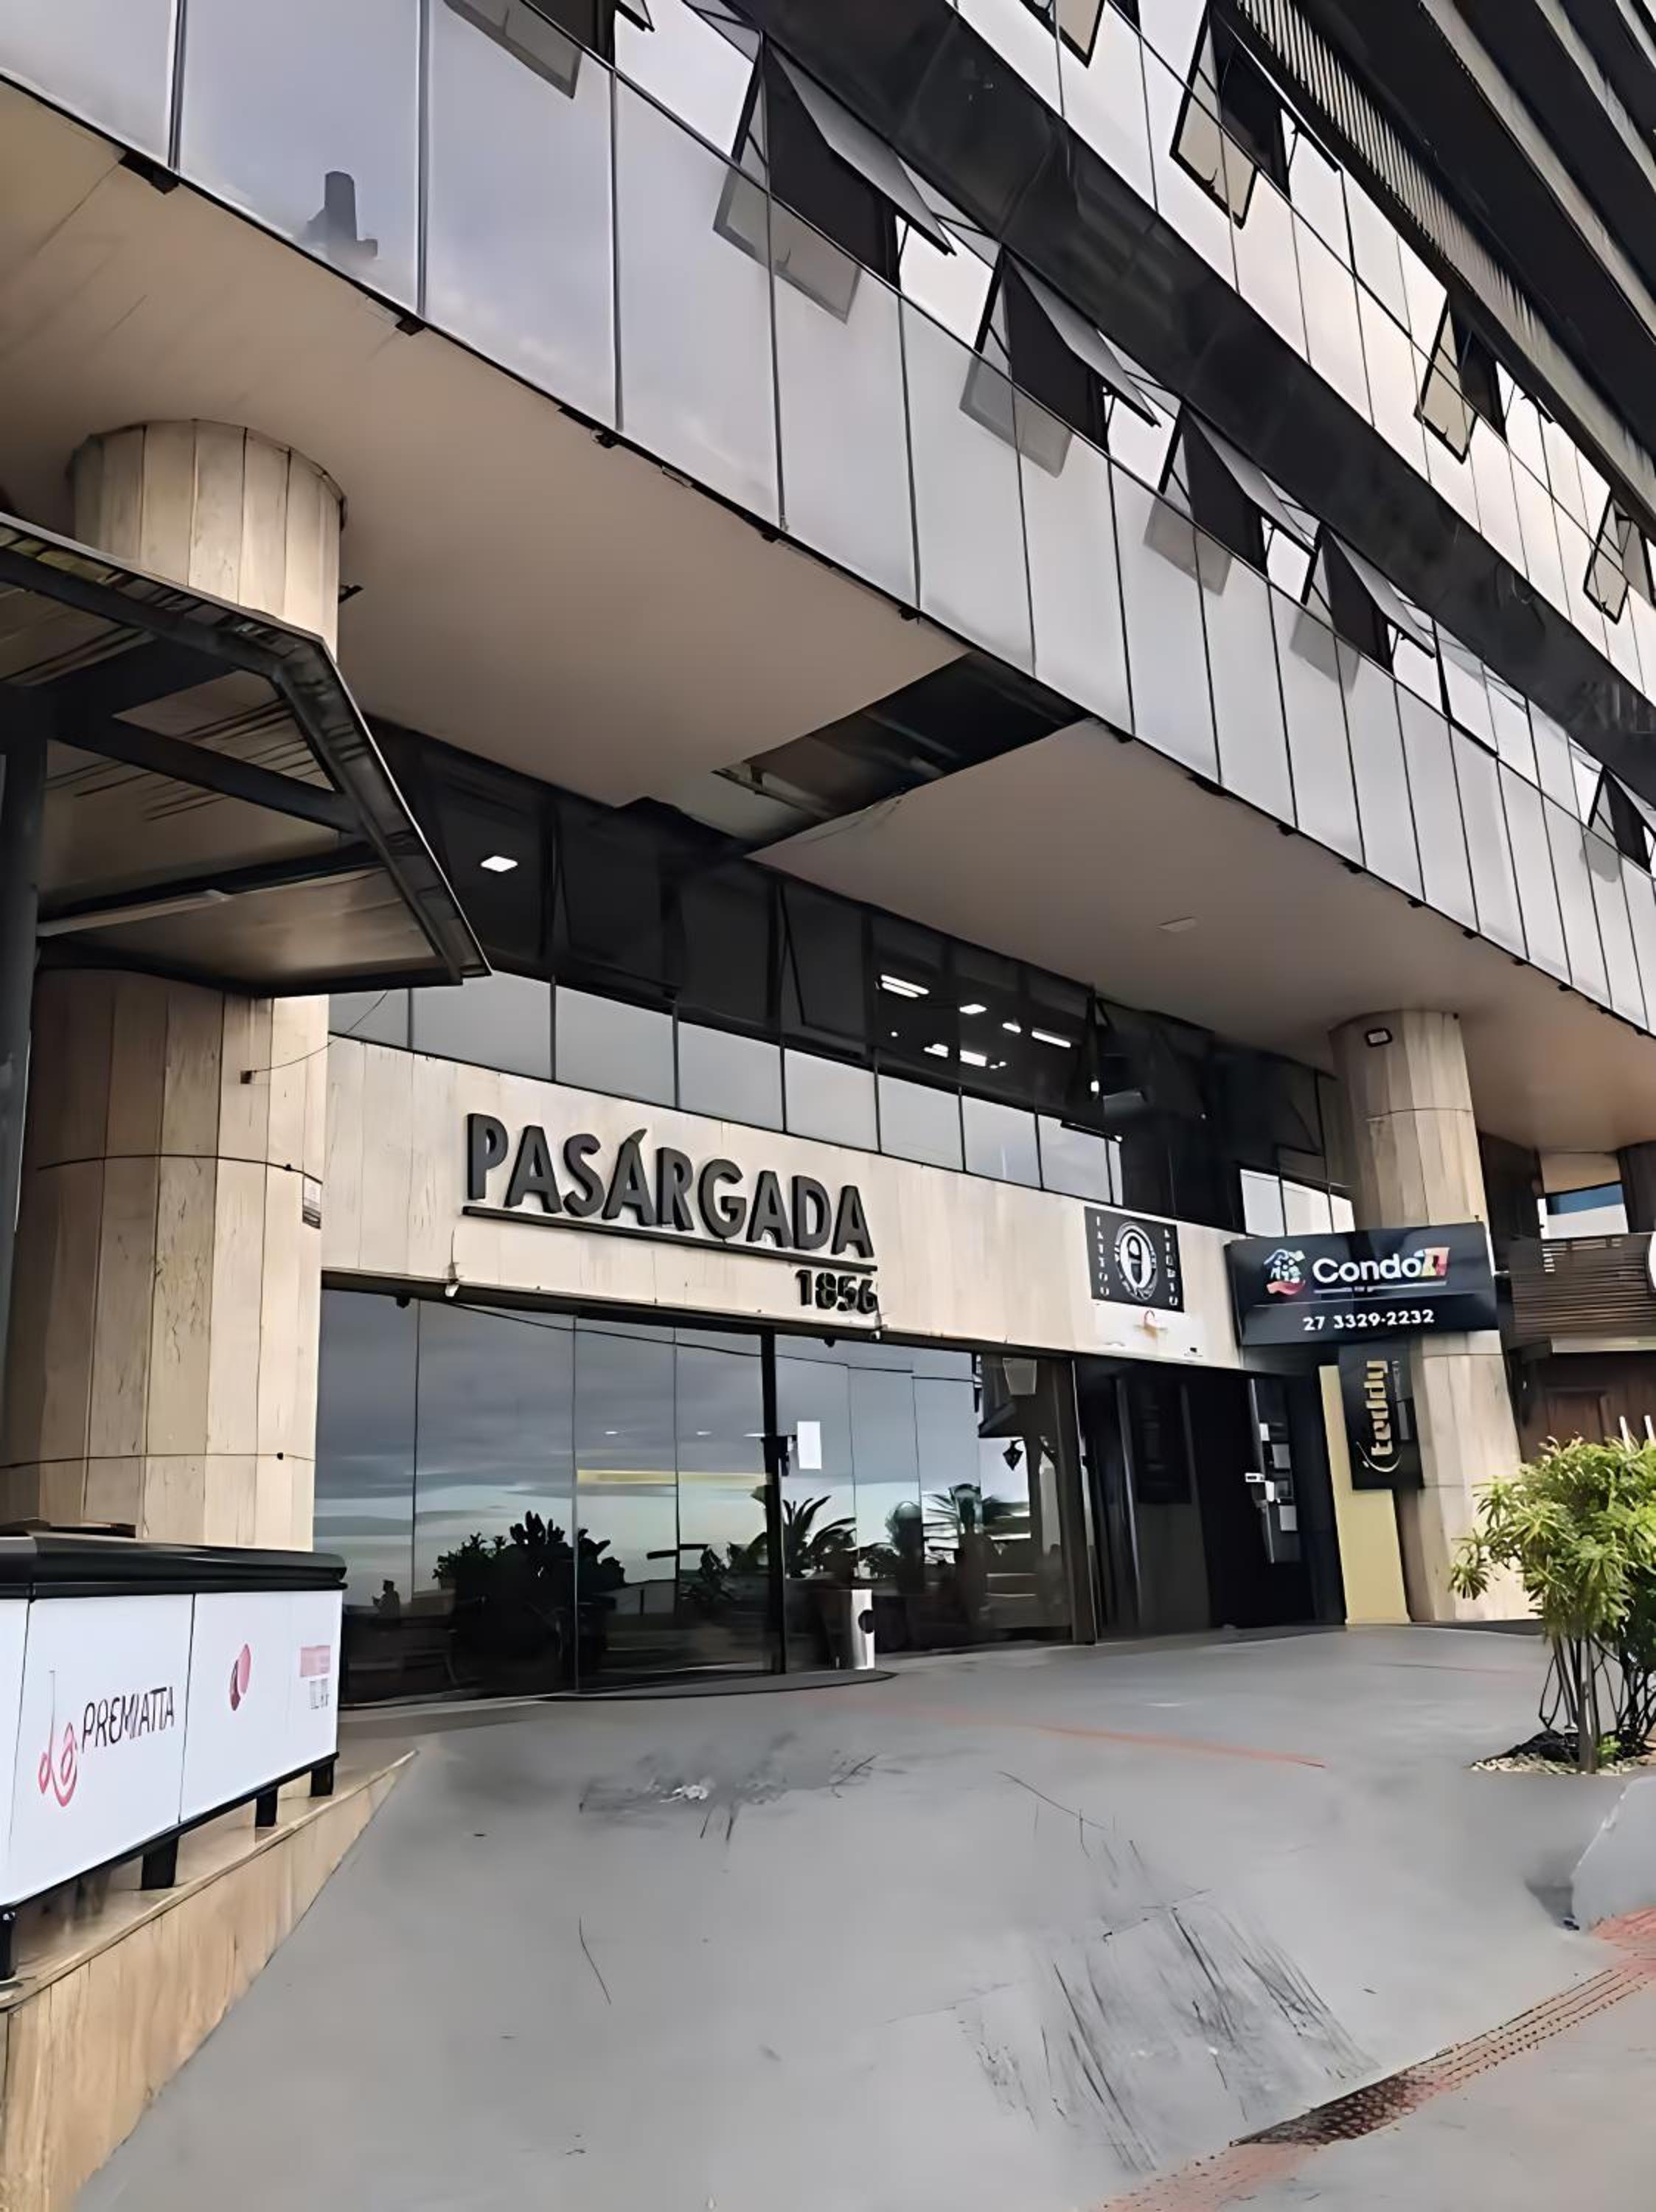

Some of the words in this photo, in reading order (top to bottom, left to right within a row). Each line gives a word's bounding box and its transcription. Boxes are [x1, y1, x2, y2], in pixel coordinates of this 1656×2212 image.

[466, 1113, 874, 1259] PASÁRGADA
[795, 1269, 879, 1314] 1856
[1302, 1316, 1325, 1332] 27
[1364, 1360, 1393, 1456] teddy
